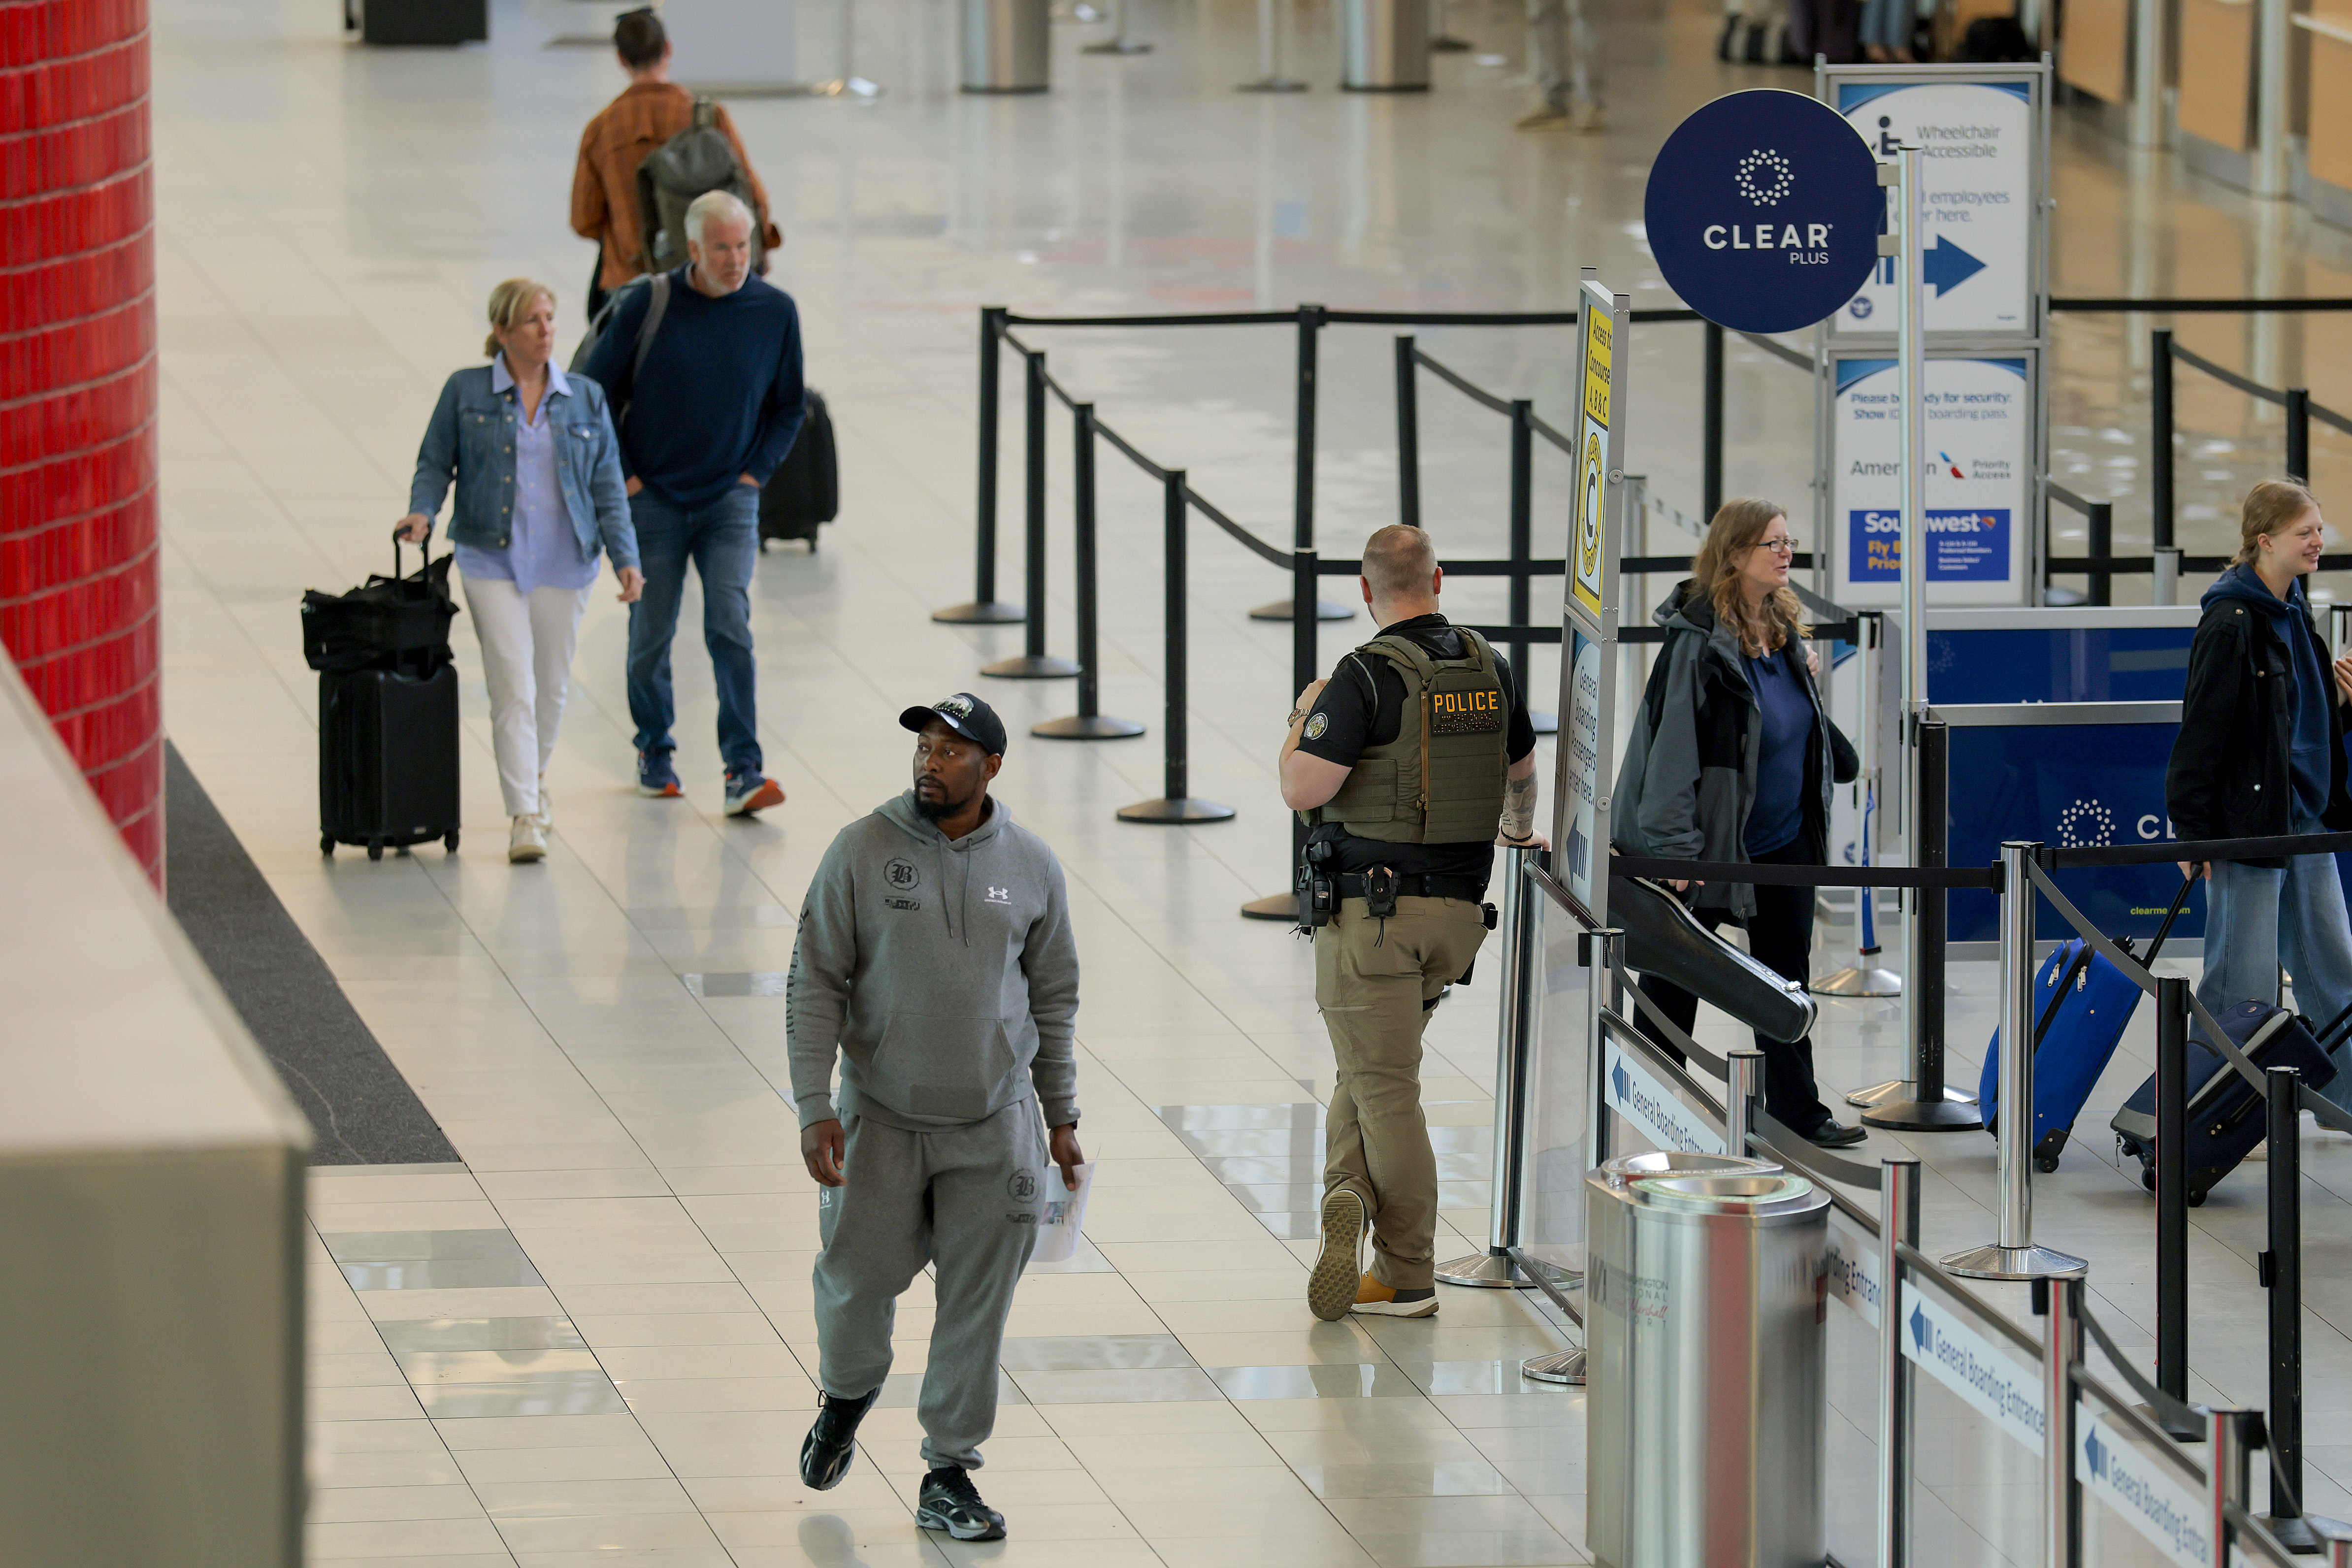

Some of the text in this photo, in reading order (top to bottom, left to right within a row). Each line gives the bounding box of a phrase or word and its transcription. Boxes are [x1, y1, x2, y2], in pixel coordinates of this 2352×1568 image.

[1916, 125, 2001, 140] Wheelchair
[1922, 145, 1997, 158] Accessible
[1929, 191, 2010, 206] employees
[1790, 252, 1829, 264] PLUS
[1593, 318, 1612, 351] Access to
[1589, 350, 1610, 385] Concourse
[1595, 389, 1598, 411] B
[1598, 392, 1602, 415] &
[1603, 396, 1607, 418] C
[1851, 393, 1888, 404] Please
[1943, 393, 1961, 403] for
[1854, 408, 1886, 420] Show
[1927, 409, 1979, 421] boarding
[1586, 472, 1596, 538] C
[1864, 512, 1981, 533] Souwest
[1868, 540, 1890, 557] Fly
[1579, 665, 1598, 701] General
[1434, 691, 1499, 713] POLICE
[1479, 712, 1492, 720] AND
[1575, 697, 1597, 742] Boarding
[1571, 730, 1596, 772] Passengers
[1569, 769, 1580, 794] enter
[1633, 1080, 1656, 1126] General
[1656, 1101, 1683, 1151] Boarding
[1936, 1328, 1967, 1379] General
[1968, 1352, 2005, 1417] Boarding
[2111, 1455, 2142, 1507] General
[2144, 1481, 2181, 1552] Boarding
